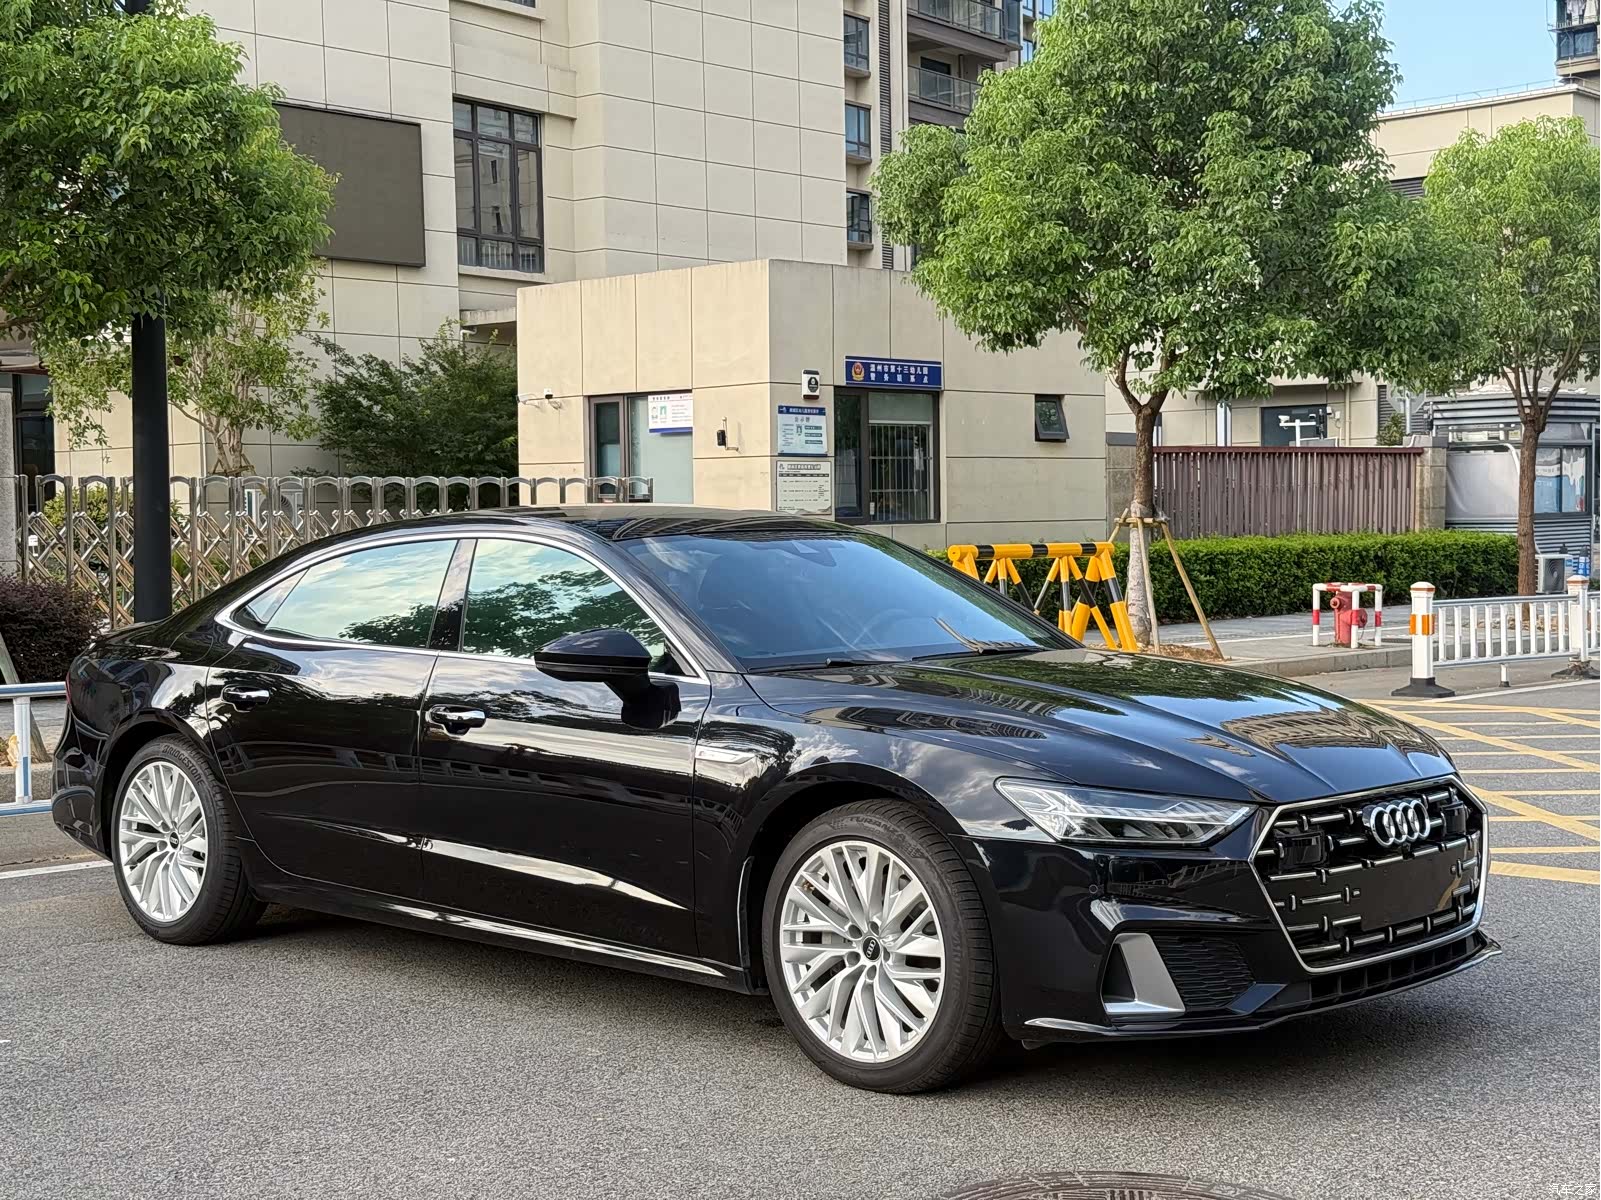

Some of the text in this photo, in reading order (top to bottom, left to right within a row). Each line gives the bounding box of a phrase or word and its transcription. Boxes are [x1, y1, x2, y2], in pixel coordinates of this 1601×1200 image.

[869, 363, 929, 375] 温州市第十三幼儿园
[869, 372, 929, 384] 警务联系点
[161, 744, 205, 786] BRIDGESTONE
[847, 816, 907, 842] TURANZA
